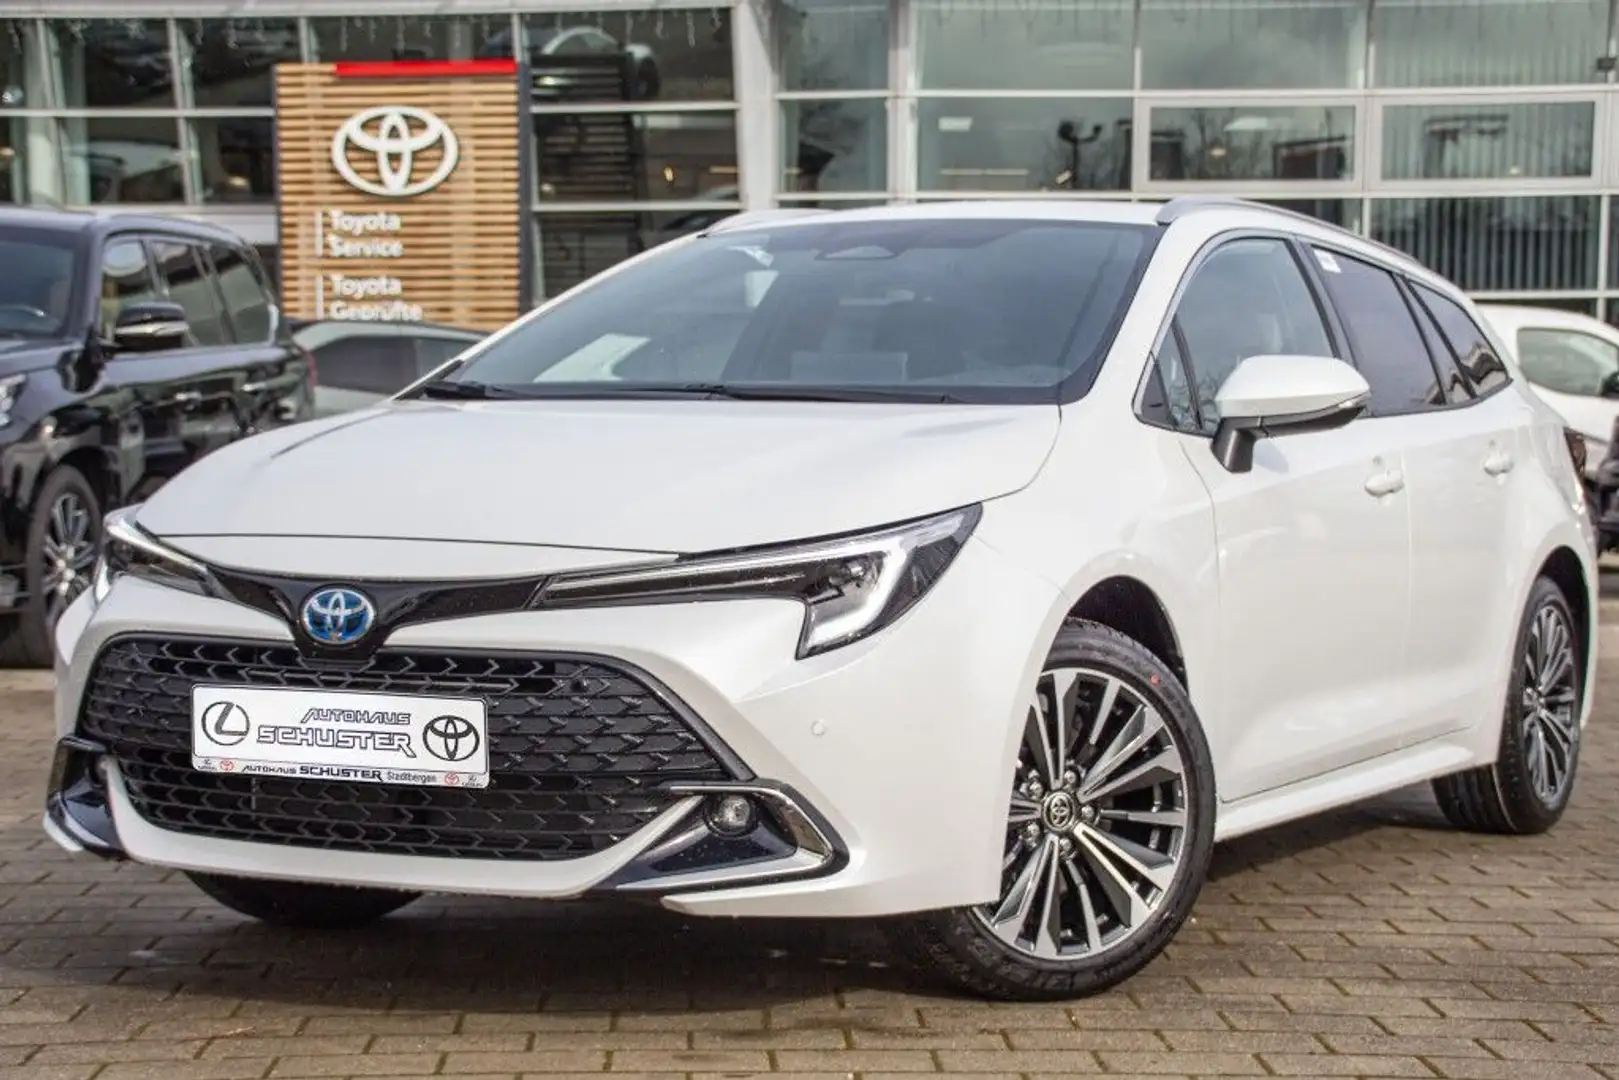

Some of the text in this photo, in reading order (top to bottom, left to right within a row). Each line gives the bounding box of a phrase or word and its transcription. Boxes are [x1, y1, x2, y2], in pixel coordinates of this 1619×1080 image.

[329, 209, 402, 236] Toyota
[328, 234, 403, 257] Service
[330, 273, 402, 299] Toyota
[300, 707, 411, 725] AUTOHAUS
[256, 725, 417, 759] SCHUSTER
[241, 765, 437, 784] AUTOHAUS SCHUSTER Stadtbergen
